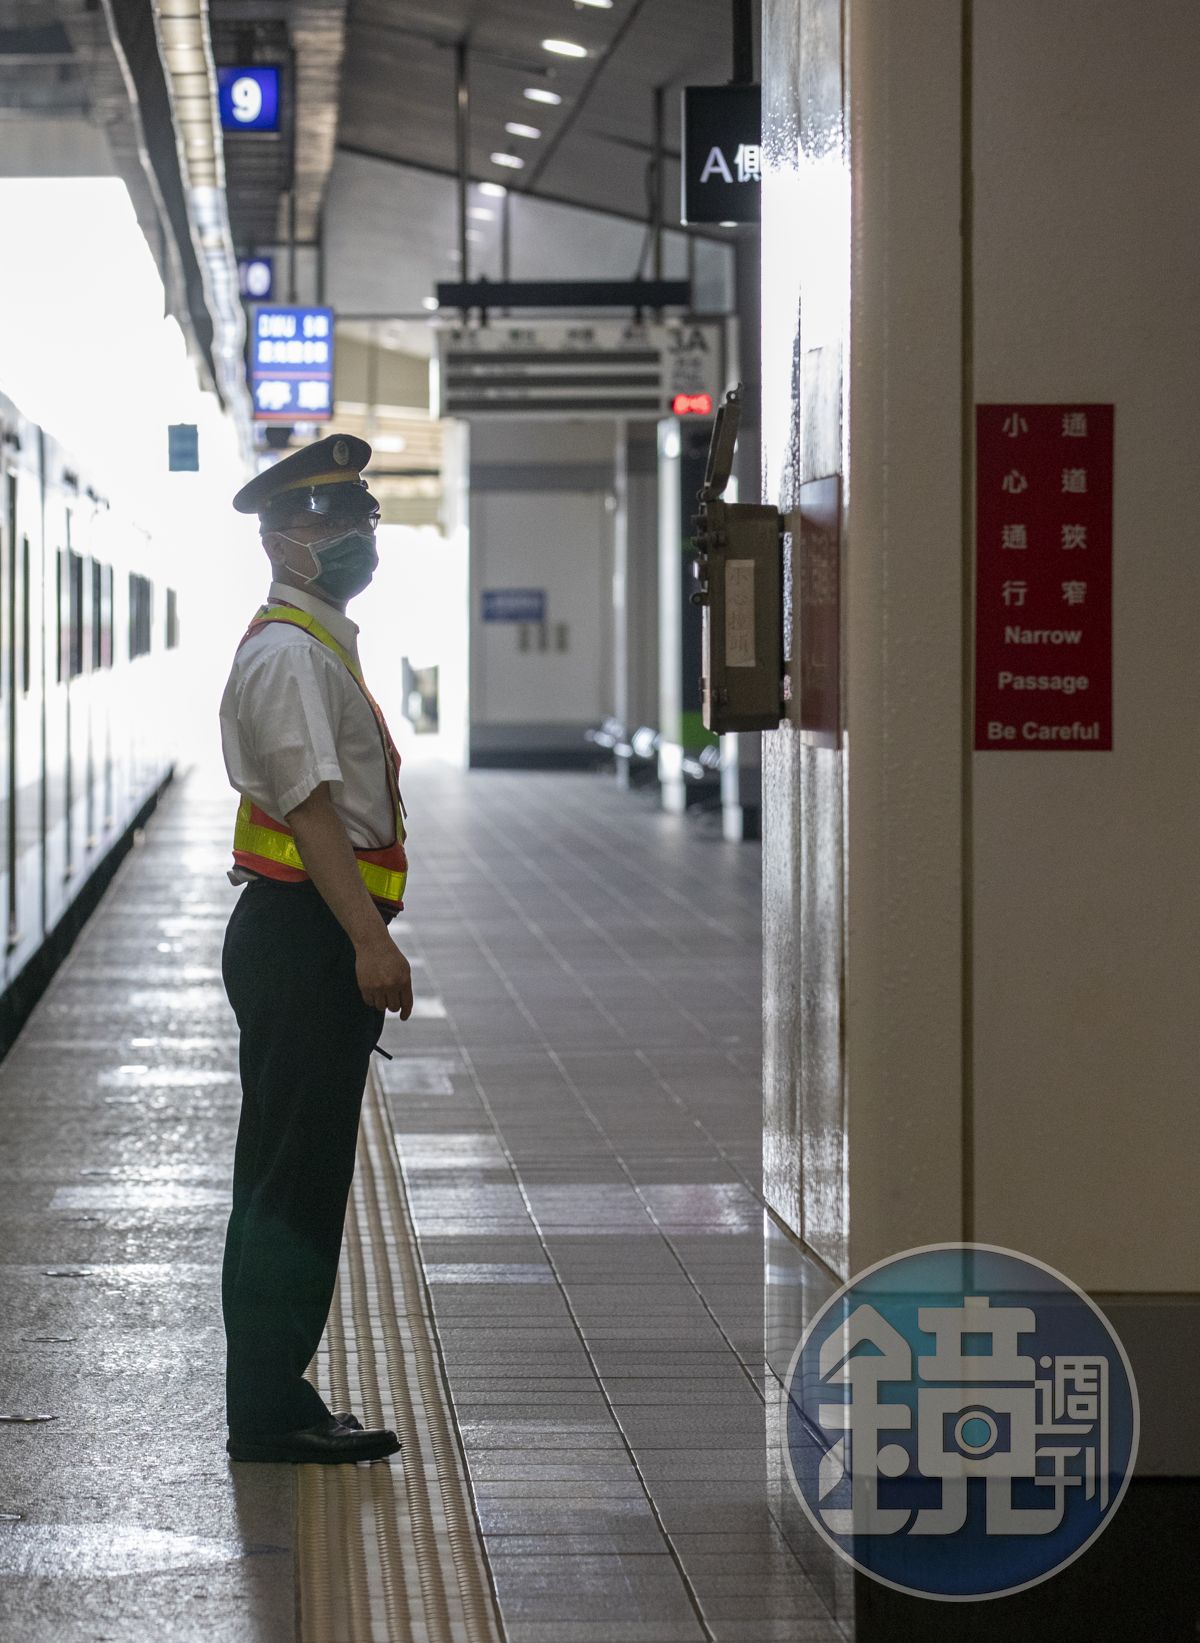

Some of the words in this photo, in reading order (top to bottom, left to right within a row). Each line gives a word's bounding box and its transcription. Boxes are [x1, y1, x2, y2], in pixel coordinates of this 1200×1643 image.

[231, 77, 262, 122] 9
[1002, 413, 1028, 606] 小心通行
[1005, 626, 1081, 644] Narrow
[998, 672, 1088, 694] Passage
[988, 722, 1015, 740] Be
[1022, 722, 1099, 740] Careful
